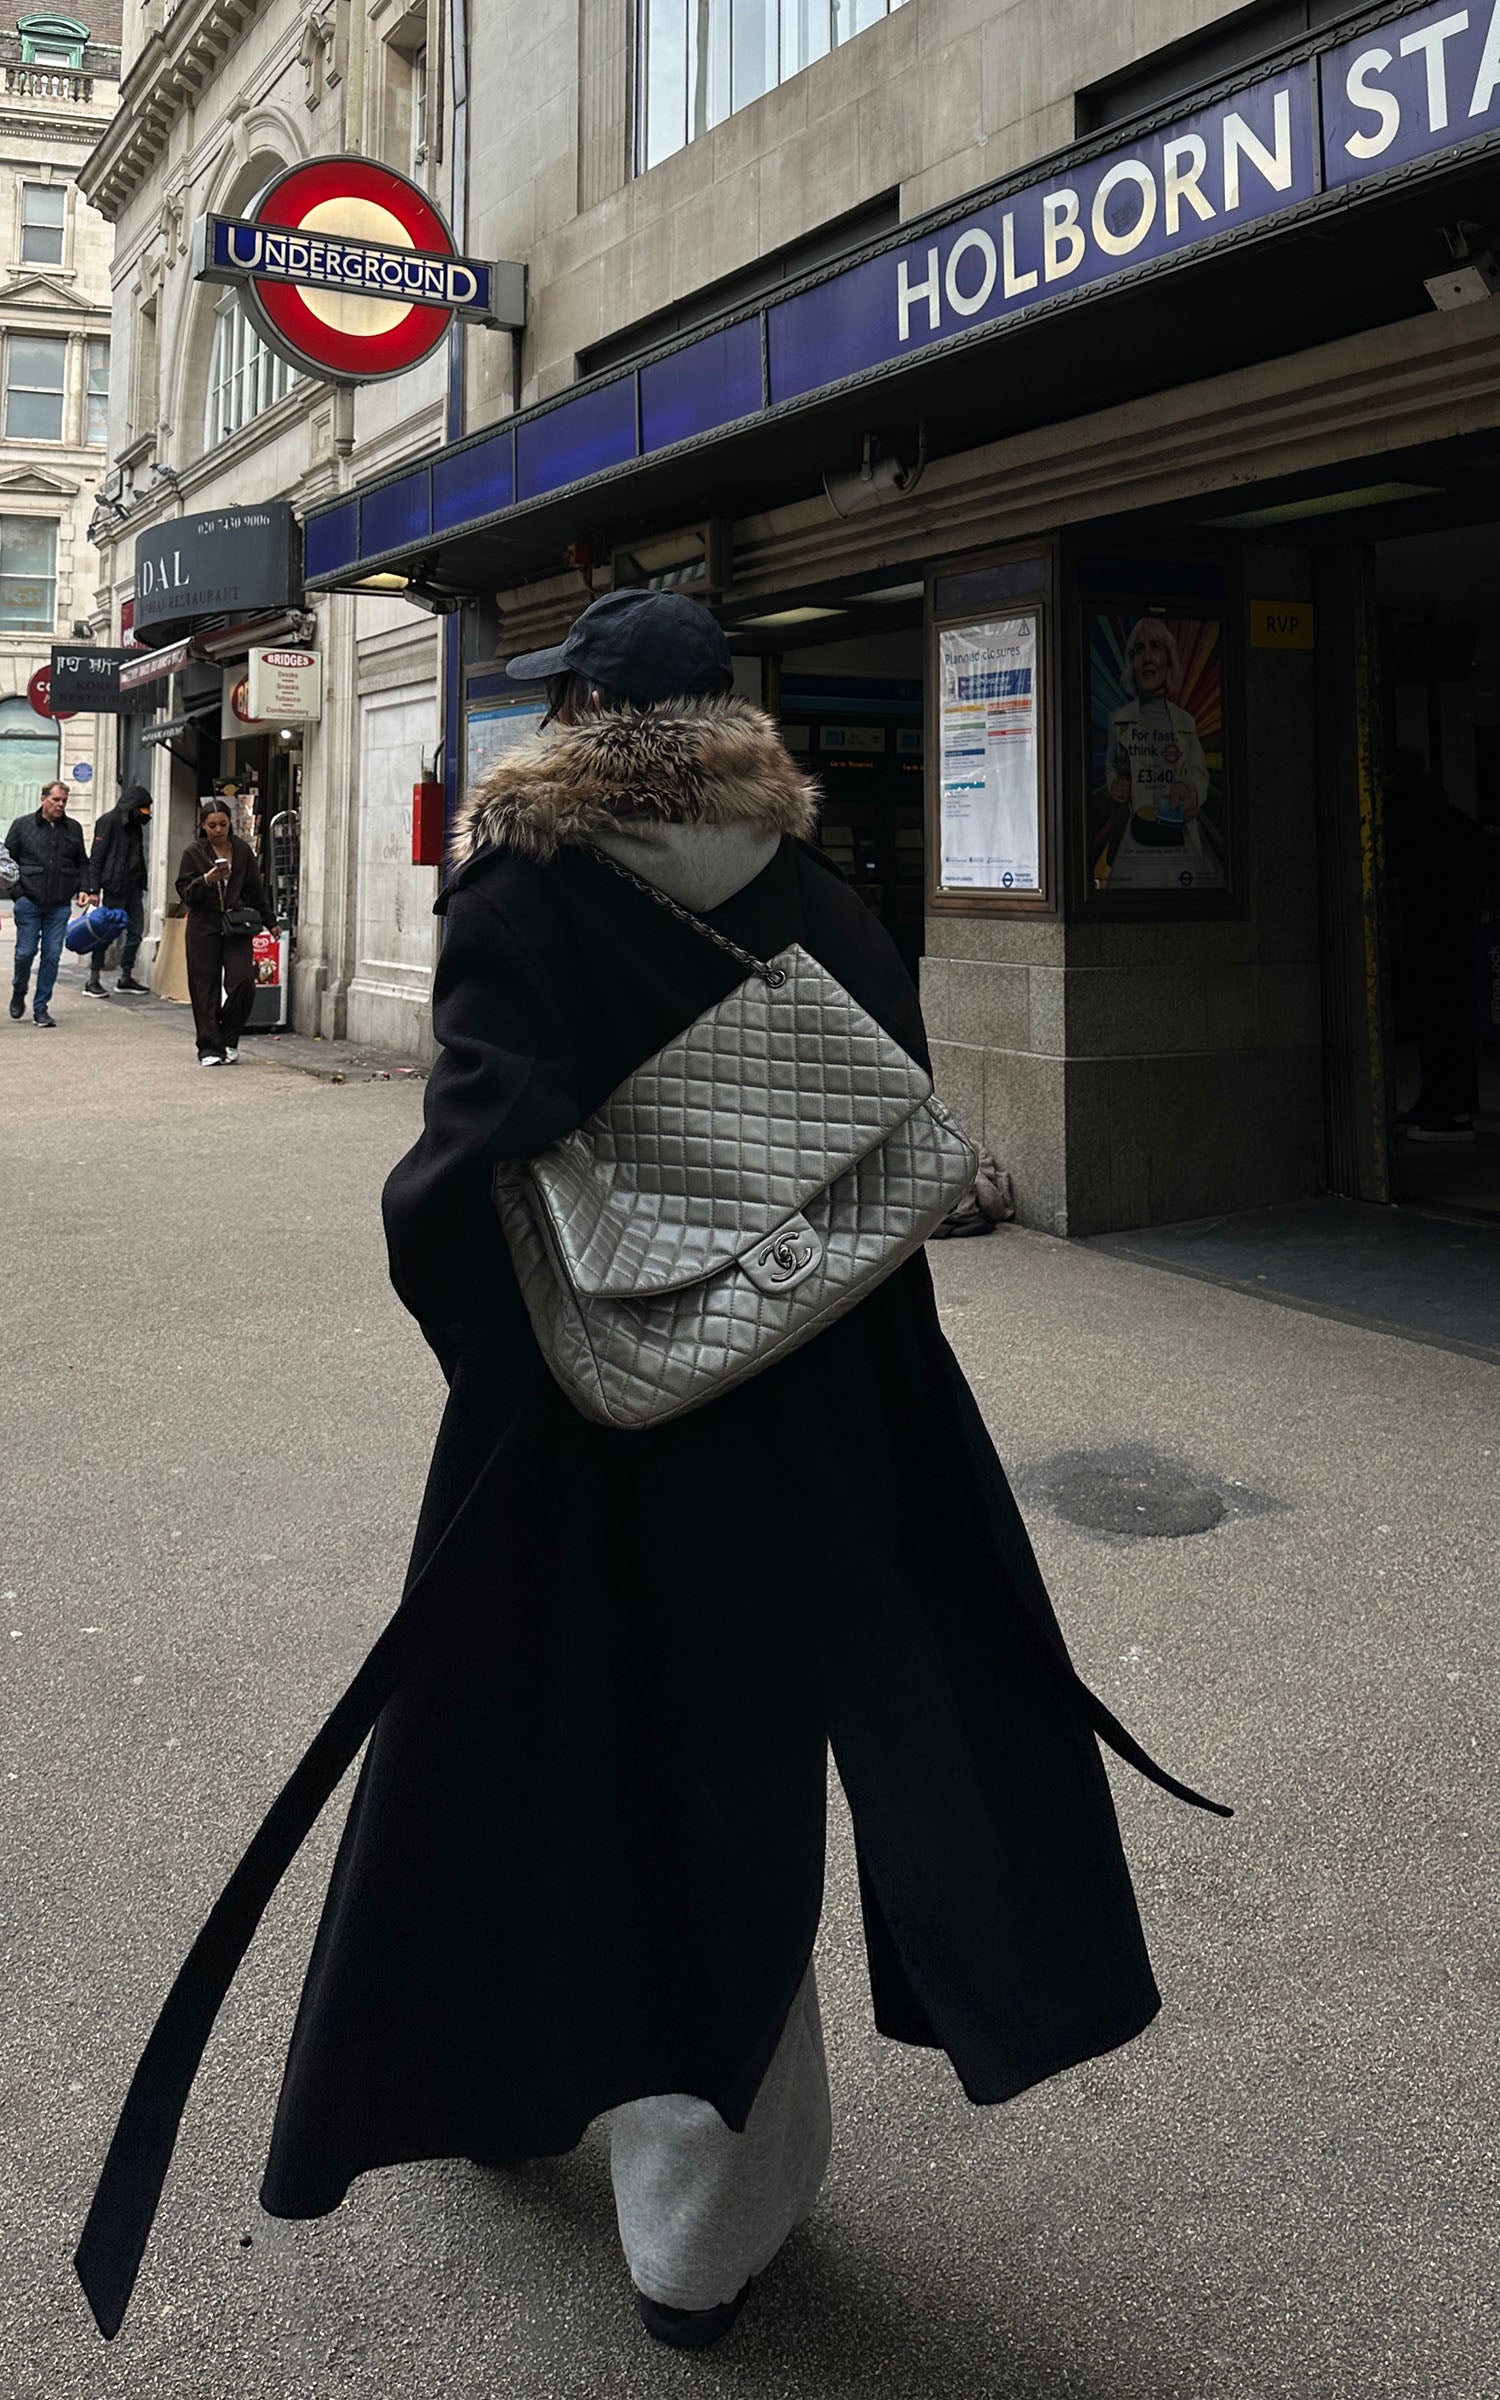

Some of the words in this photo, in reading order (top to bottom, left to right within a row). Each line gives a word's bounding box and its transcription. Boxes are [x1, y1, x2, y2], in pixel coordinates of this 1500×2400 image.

[898, 89, 1292, 342] HOLBORN
[227, 226, 478, 303] UNDERGROUND
[198, 521, 215, 535] 020
[218, 516, 241, 531] 7430
[243, 514, 270, 526] 9006
[168, 586, 240, 611] RESTAURANT
[1266, 615, 1298, 633] RVP
[267, 653, 310, 667] BRIDGES
[945, 650, 980, 665] Planned
[982, 646, 1021, 660] closures
[277, 670, 298, 679] Drinks
[276, 683, 299, 691] Snacks
[275, 695, 301, 703] Tobacco
[266, 706, 310, 717] Confectionery
[1132, 729, 1149, 741] For
[1129, 744, 1159, 757] think
[1137, 768, 1173, 784] £3.40
